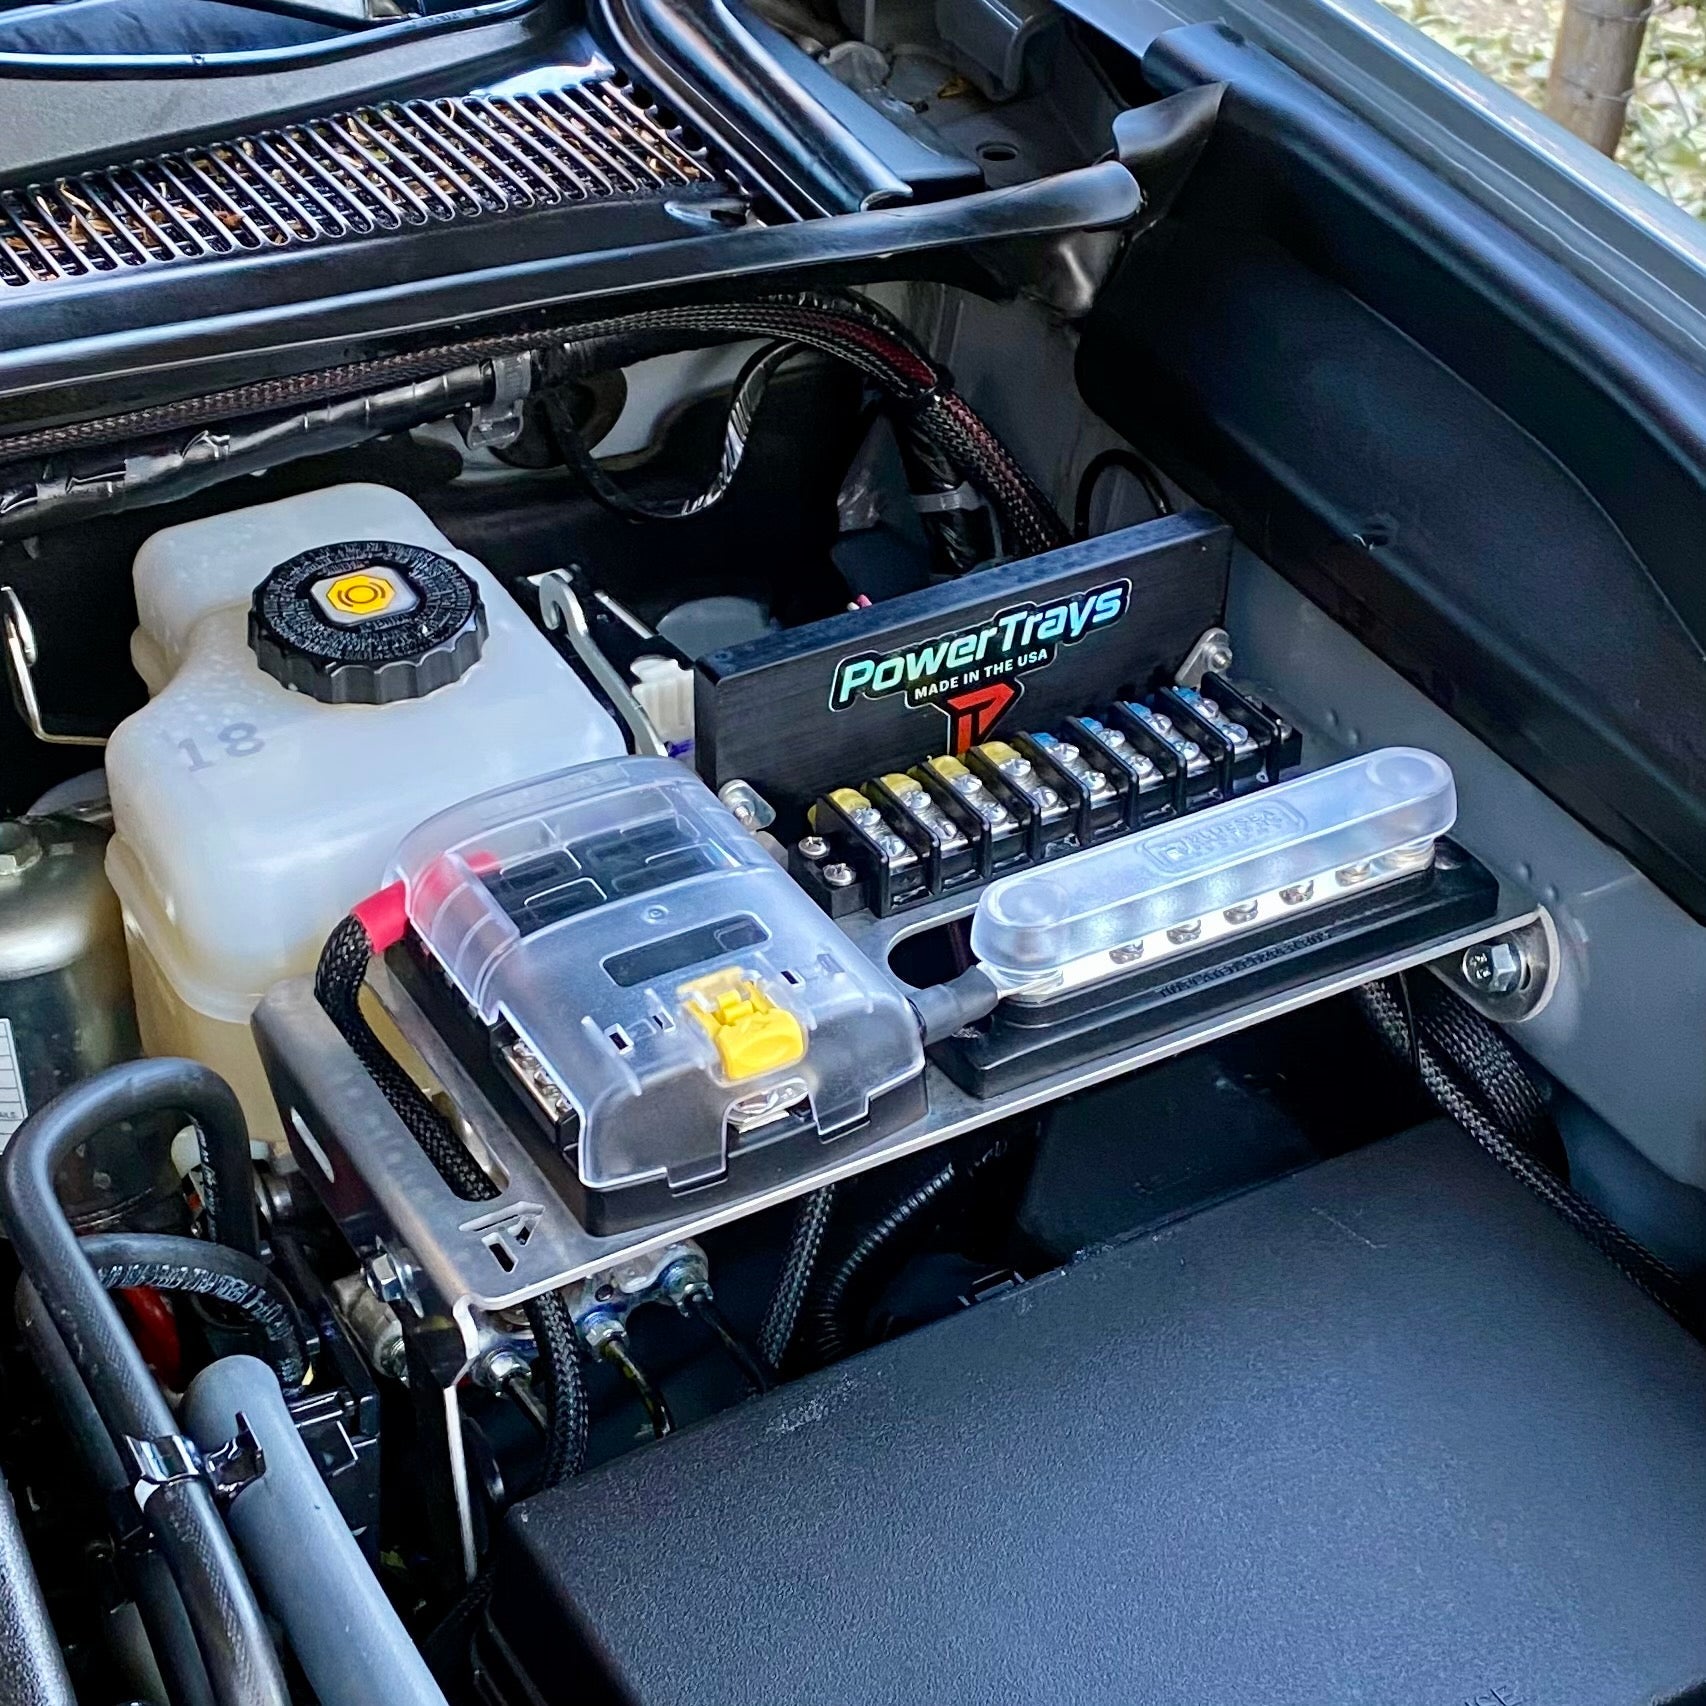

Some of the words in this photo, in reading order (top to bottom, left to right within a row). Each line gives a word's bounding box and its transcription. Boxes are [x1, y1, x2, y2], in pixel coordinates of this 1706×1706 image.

[838, 586, 1122, 703] PowerTrays
[914, 676, 959, 700] MADE
[963, 669, 979, 685] IN
[984, 659, 1014, 678] THE
[1017, 648, 1048, 667] USA
[178, 721, 265, 772] 18
